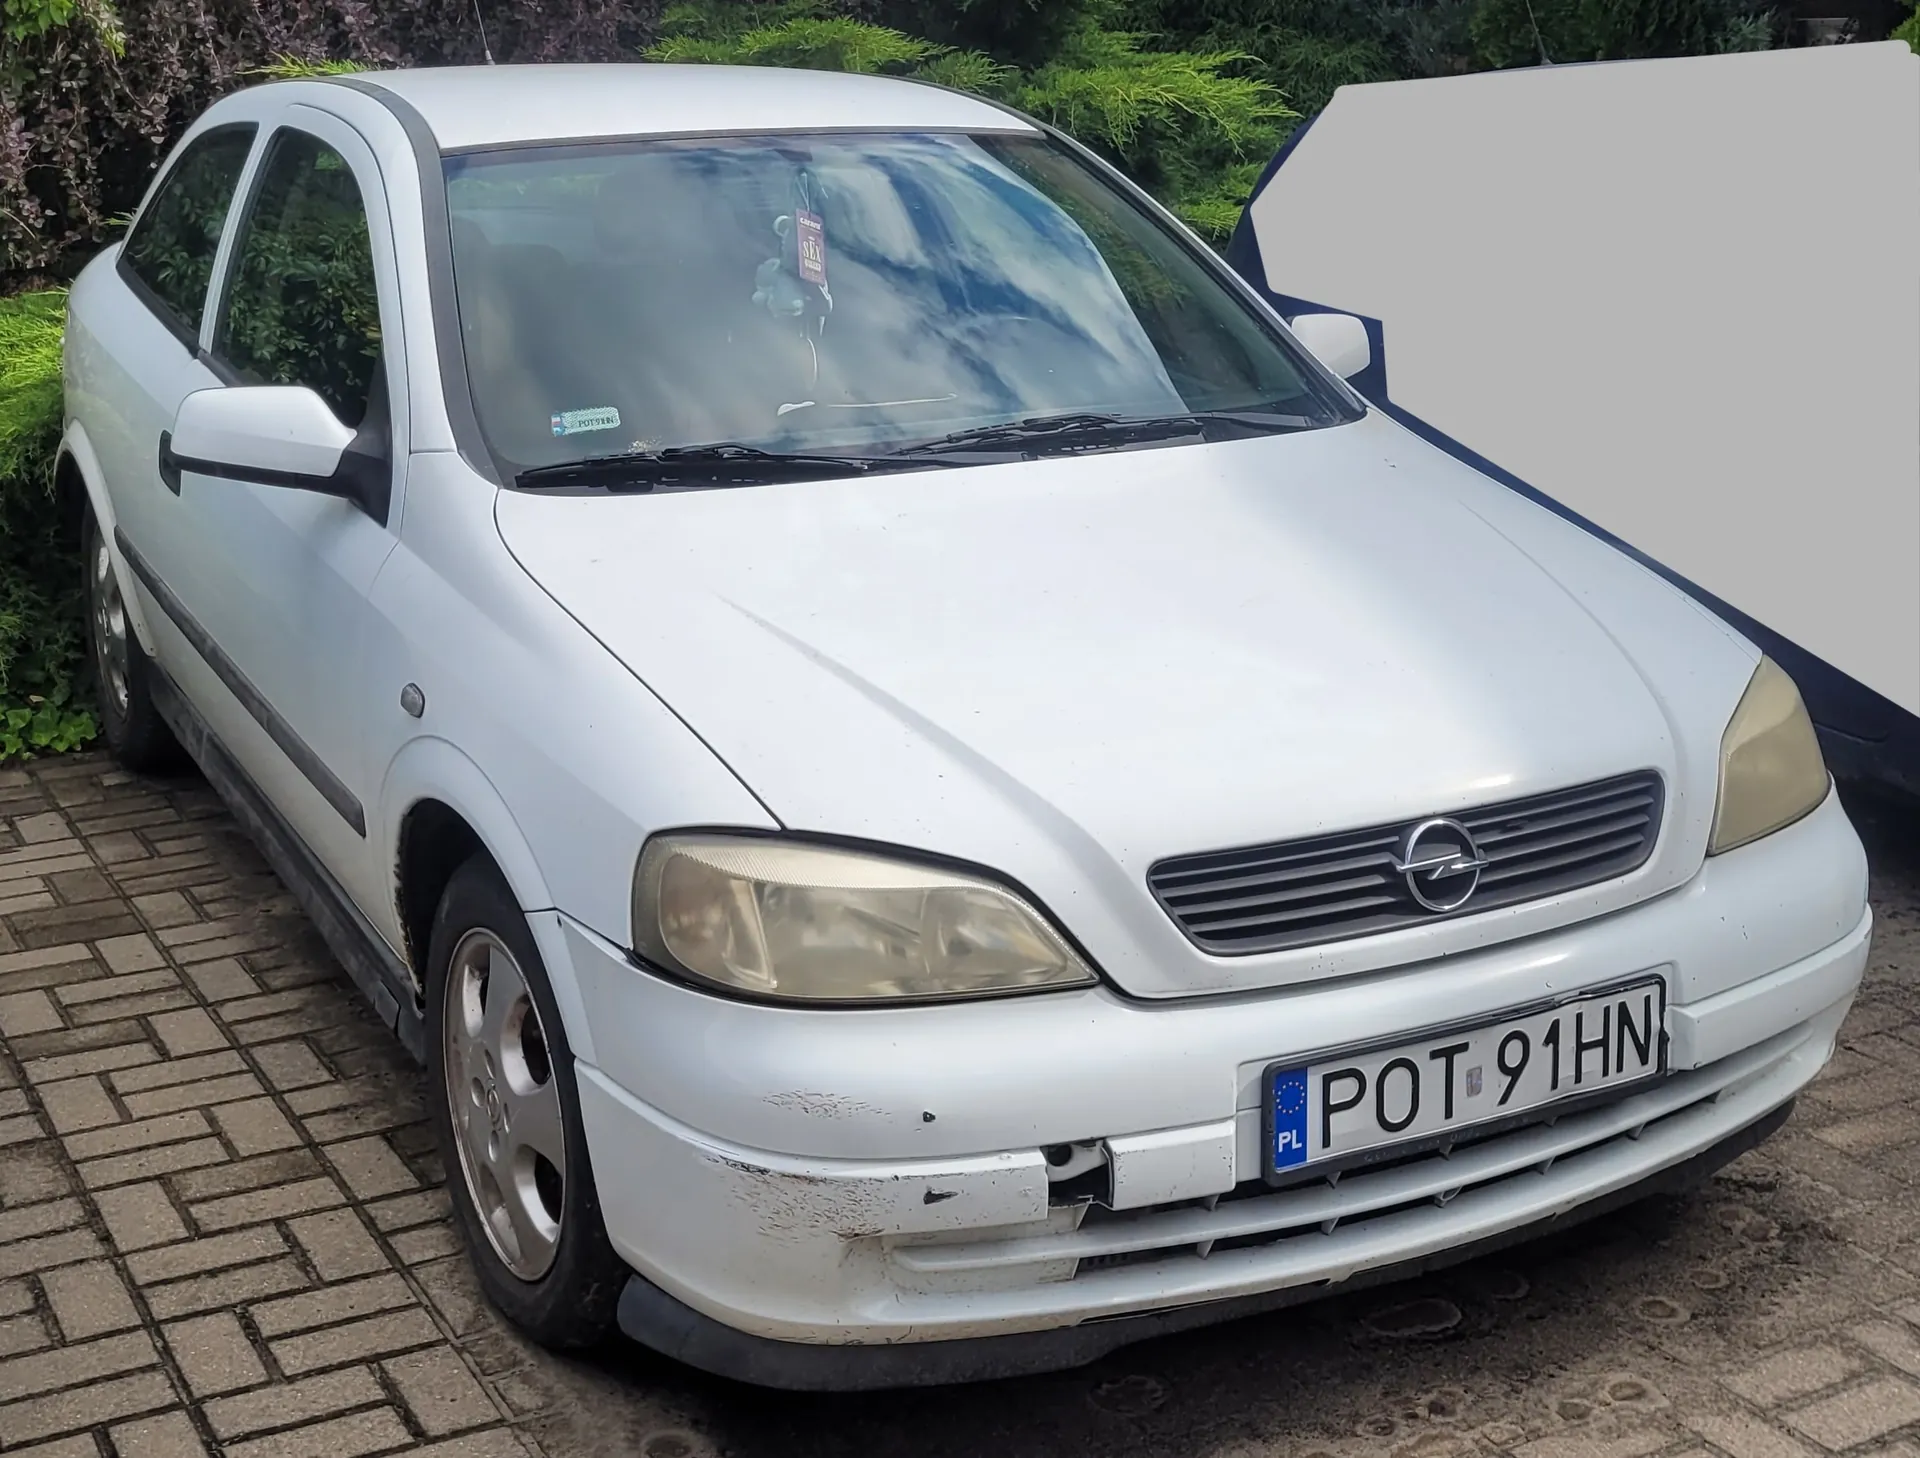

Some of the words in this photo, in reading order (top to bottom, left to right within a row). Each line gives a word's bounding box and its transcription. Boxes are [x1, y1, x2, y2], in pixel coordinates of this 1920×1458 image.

[1322, 1042, 1470, 1149] POT
[1497, 995, 1652, 1106] 91HN
[1278, 1130, 1302, 1152] PL
